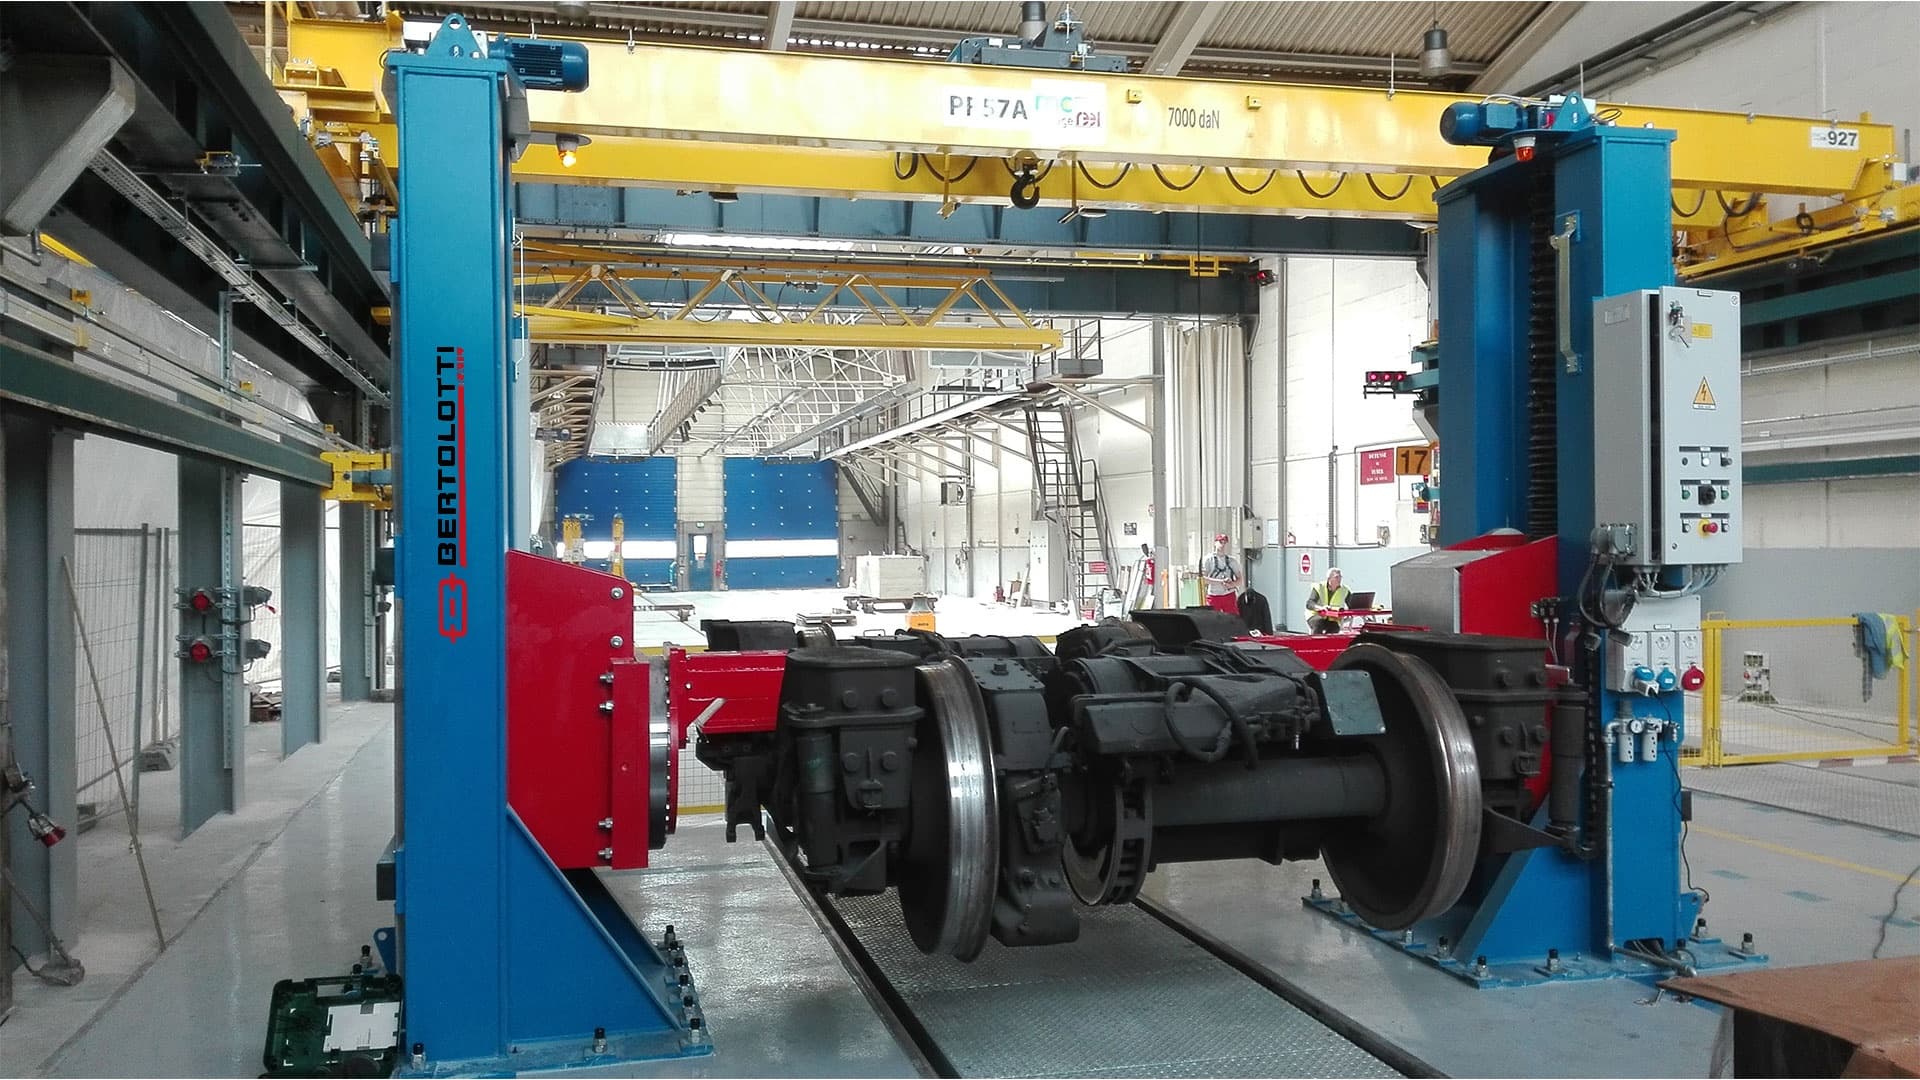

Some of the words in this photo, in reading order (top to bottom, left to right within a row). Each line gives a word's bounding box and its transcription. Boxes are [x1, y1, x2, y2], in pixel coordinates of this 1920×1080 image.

[1168, 107, 1196, 127] 7000
[1198, 109, 1220, 129] daN
[1827, 130, 1858, 147] 927
[436, 346, 457, 566] BERTOLOTTI
[1401, 449, 1429, 475] 17
